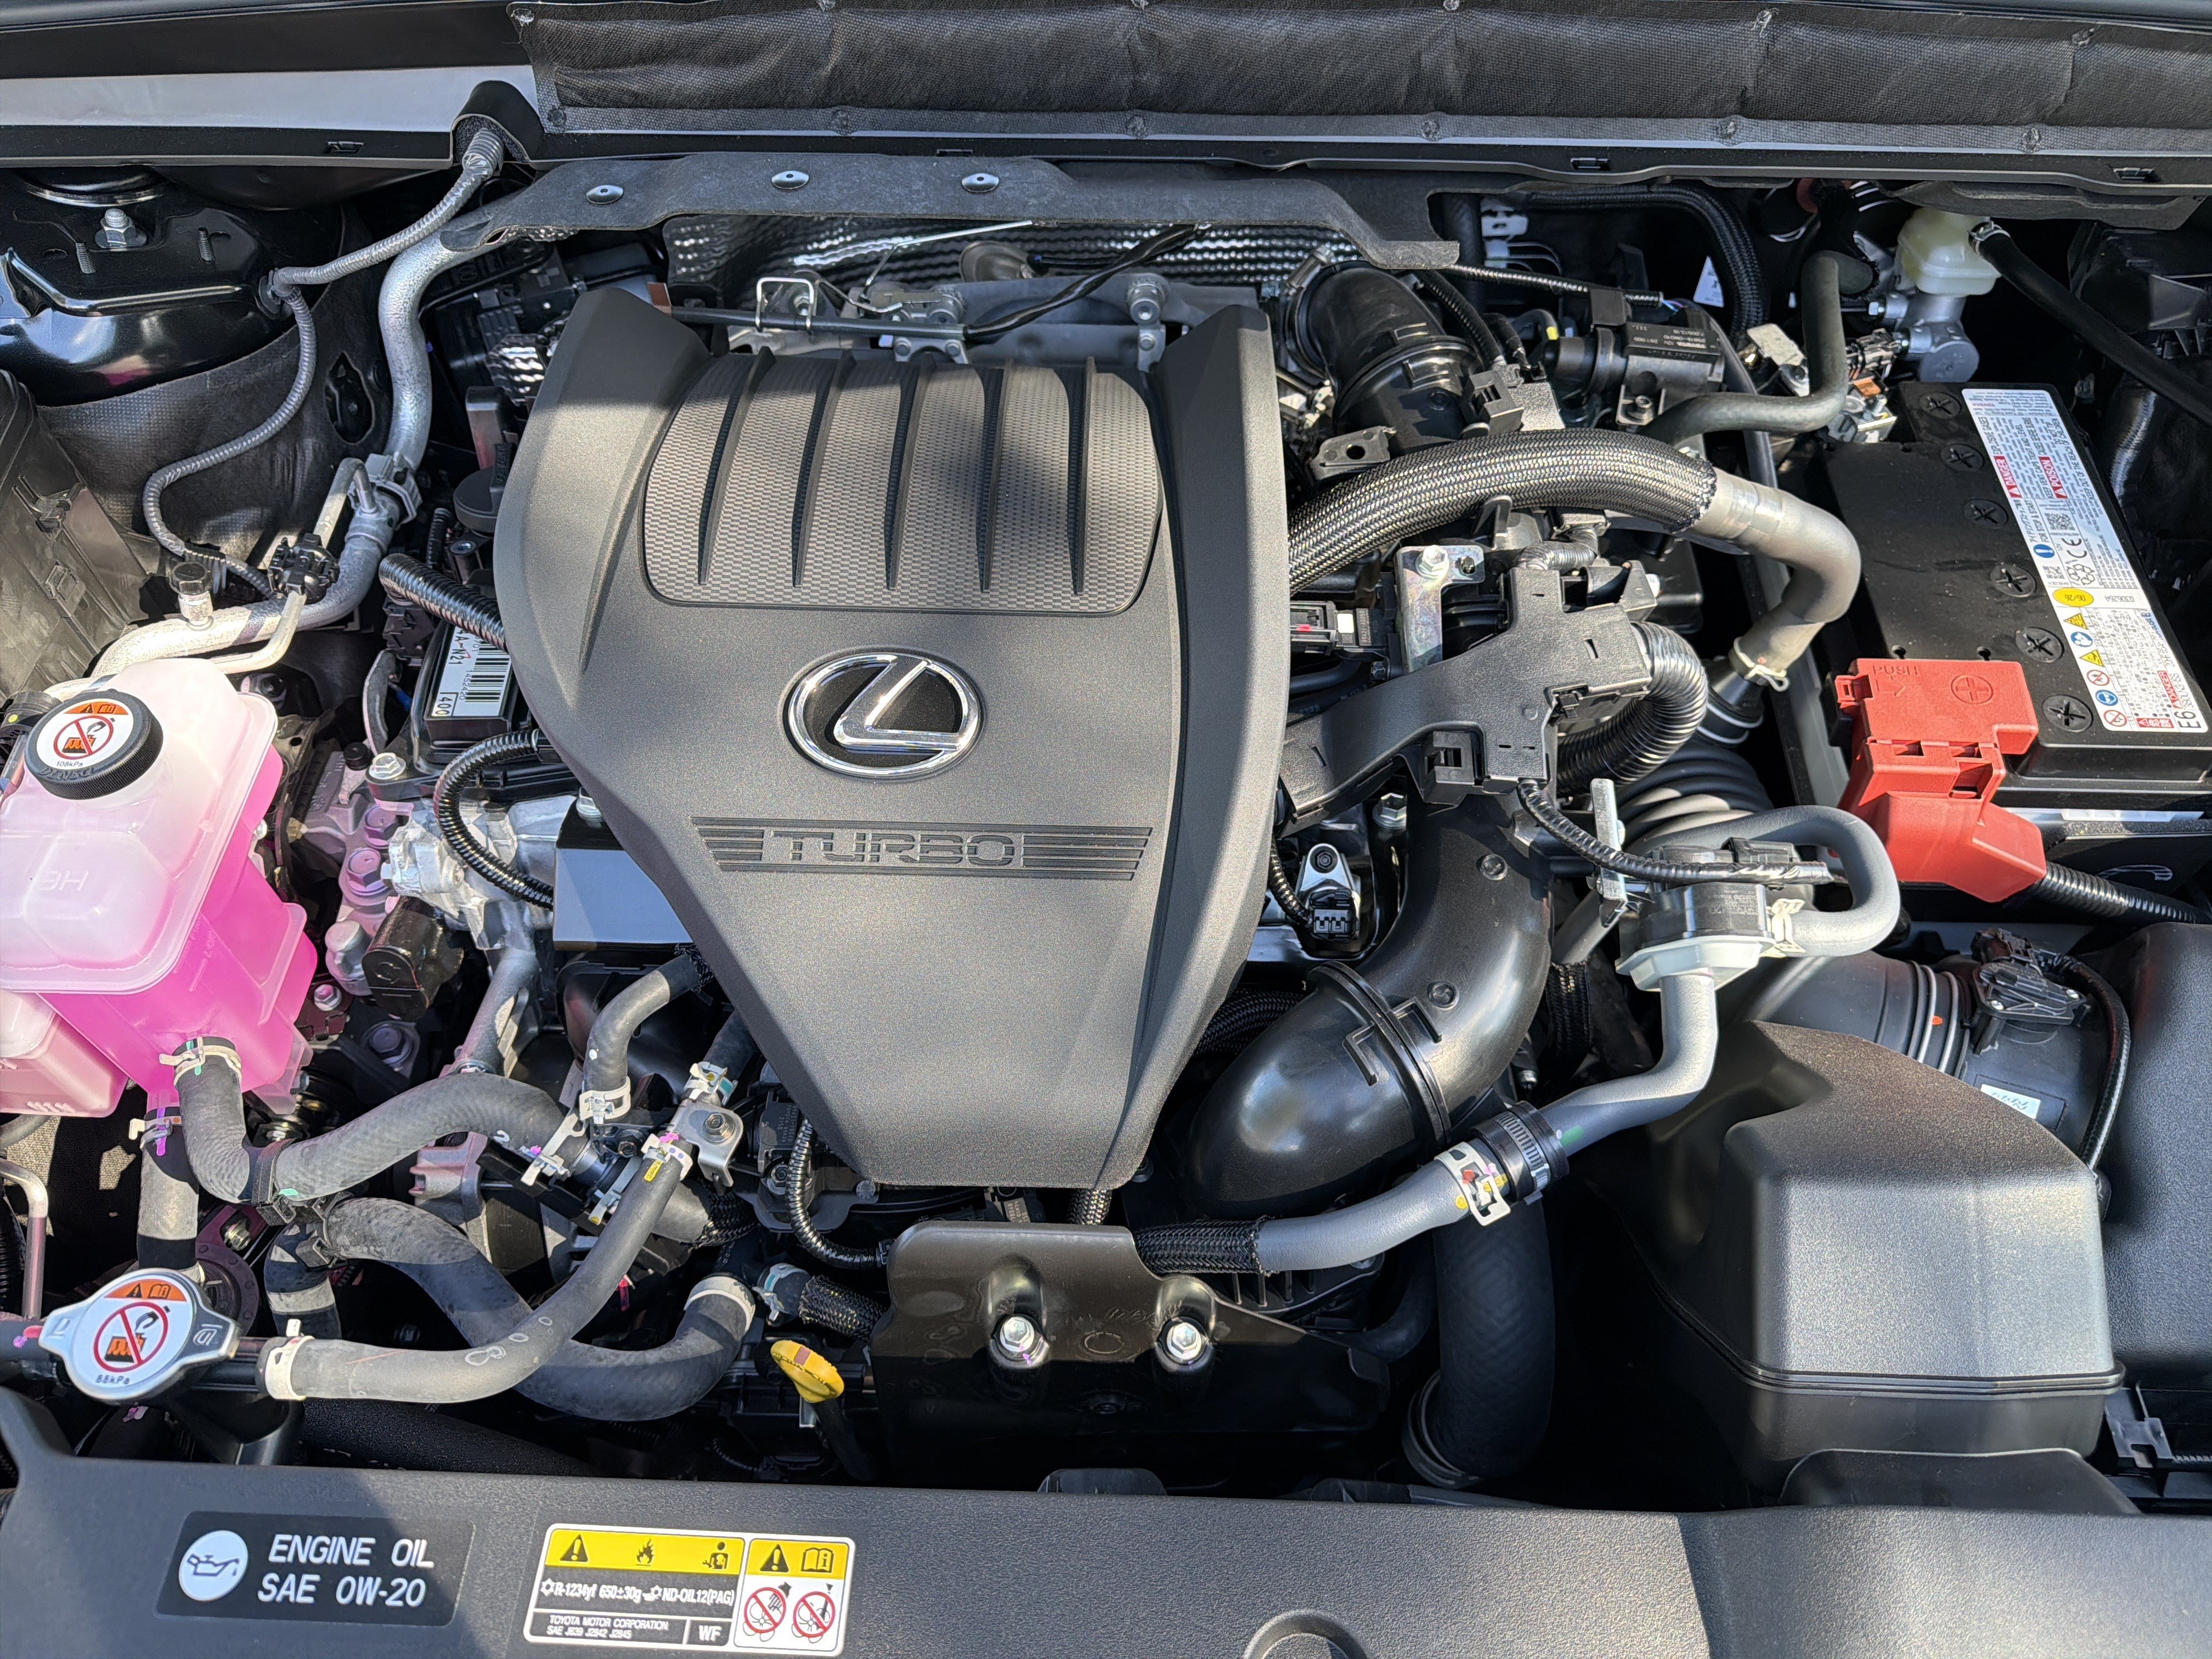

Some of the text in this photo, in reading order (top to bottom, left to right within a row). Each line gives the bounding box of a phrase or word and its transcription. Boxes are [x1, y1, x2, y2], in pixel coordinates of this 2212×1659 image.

[1995, 459, 2016, 485] DANGER
[2040, 459, 2062, 487] POISON
[1872, 665, 1918, 676] PUSH
[459, 670, 472, 700] 1452420
[2157, 670, 2179, 699] DANGER
[435, 697, 453, 715] 400
[2172, 710, 2202, 728] E6
[770, 830, 1015, 866] TURBO
[268, 1533, 435, 1568] ENGINE OIL
[257, 1572, 426, 1607] SAE 0W-20
[599, 1584, 641, 1604] 650±30g
[662, 1586, 734, 1606] ND-OIL12(PAG)
[546, 1626, 563, 1635] SAE
[550, 1615, 668, 1630] TOYOTA MOTOR CORPORATION
[698, 1625, 720, 1641] WF
